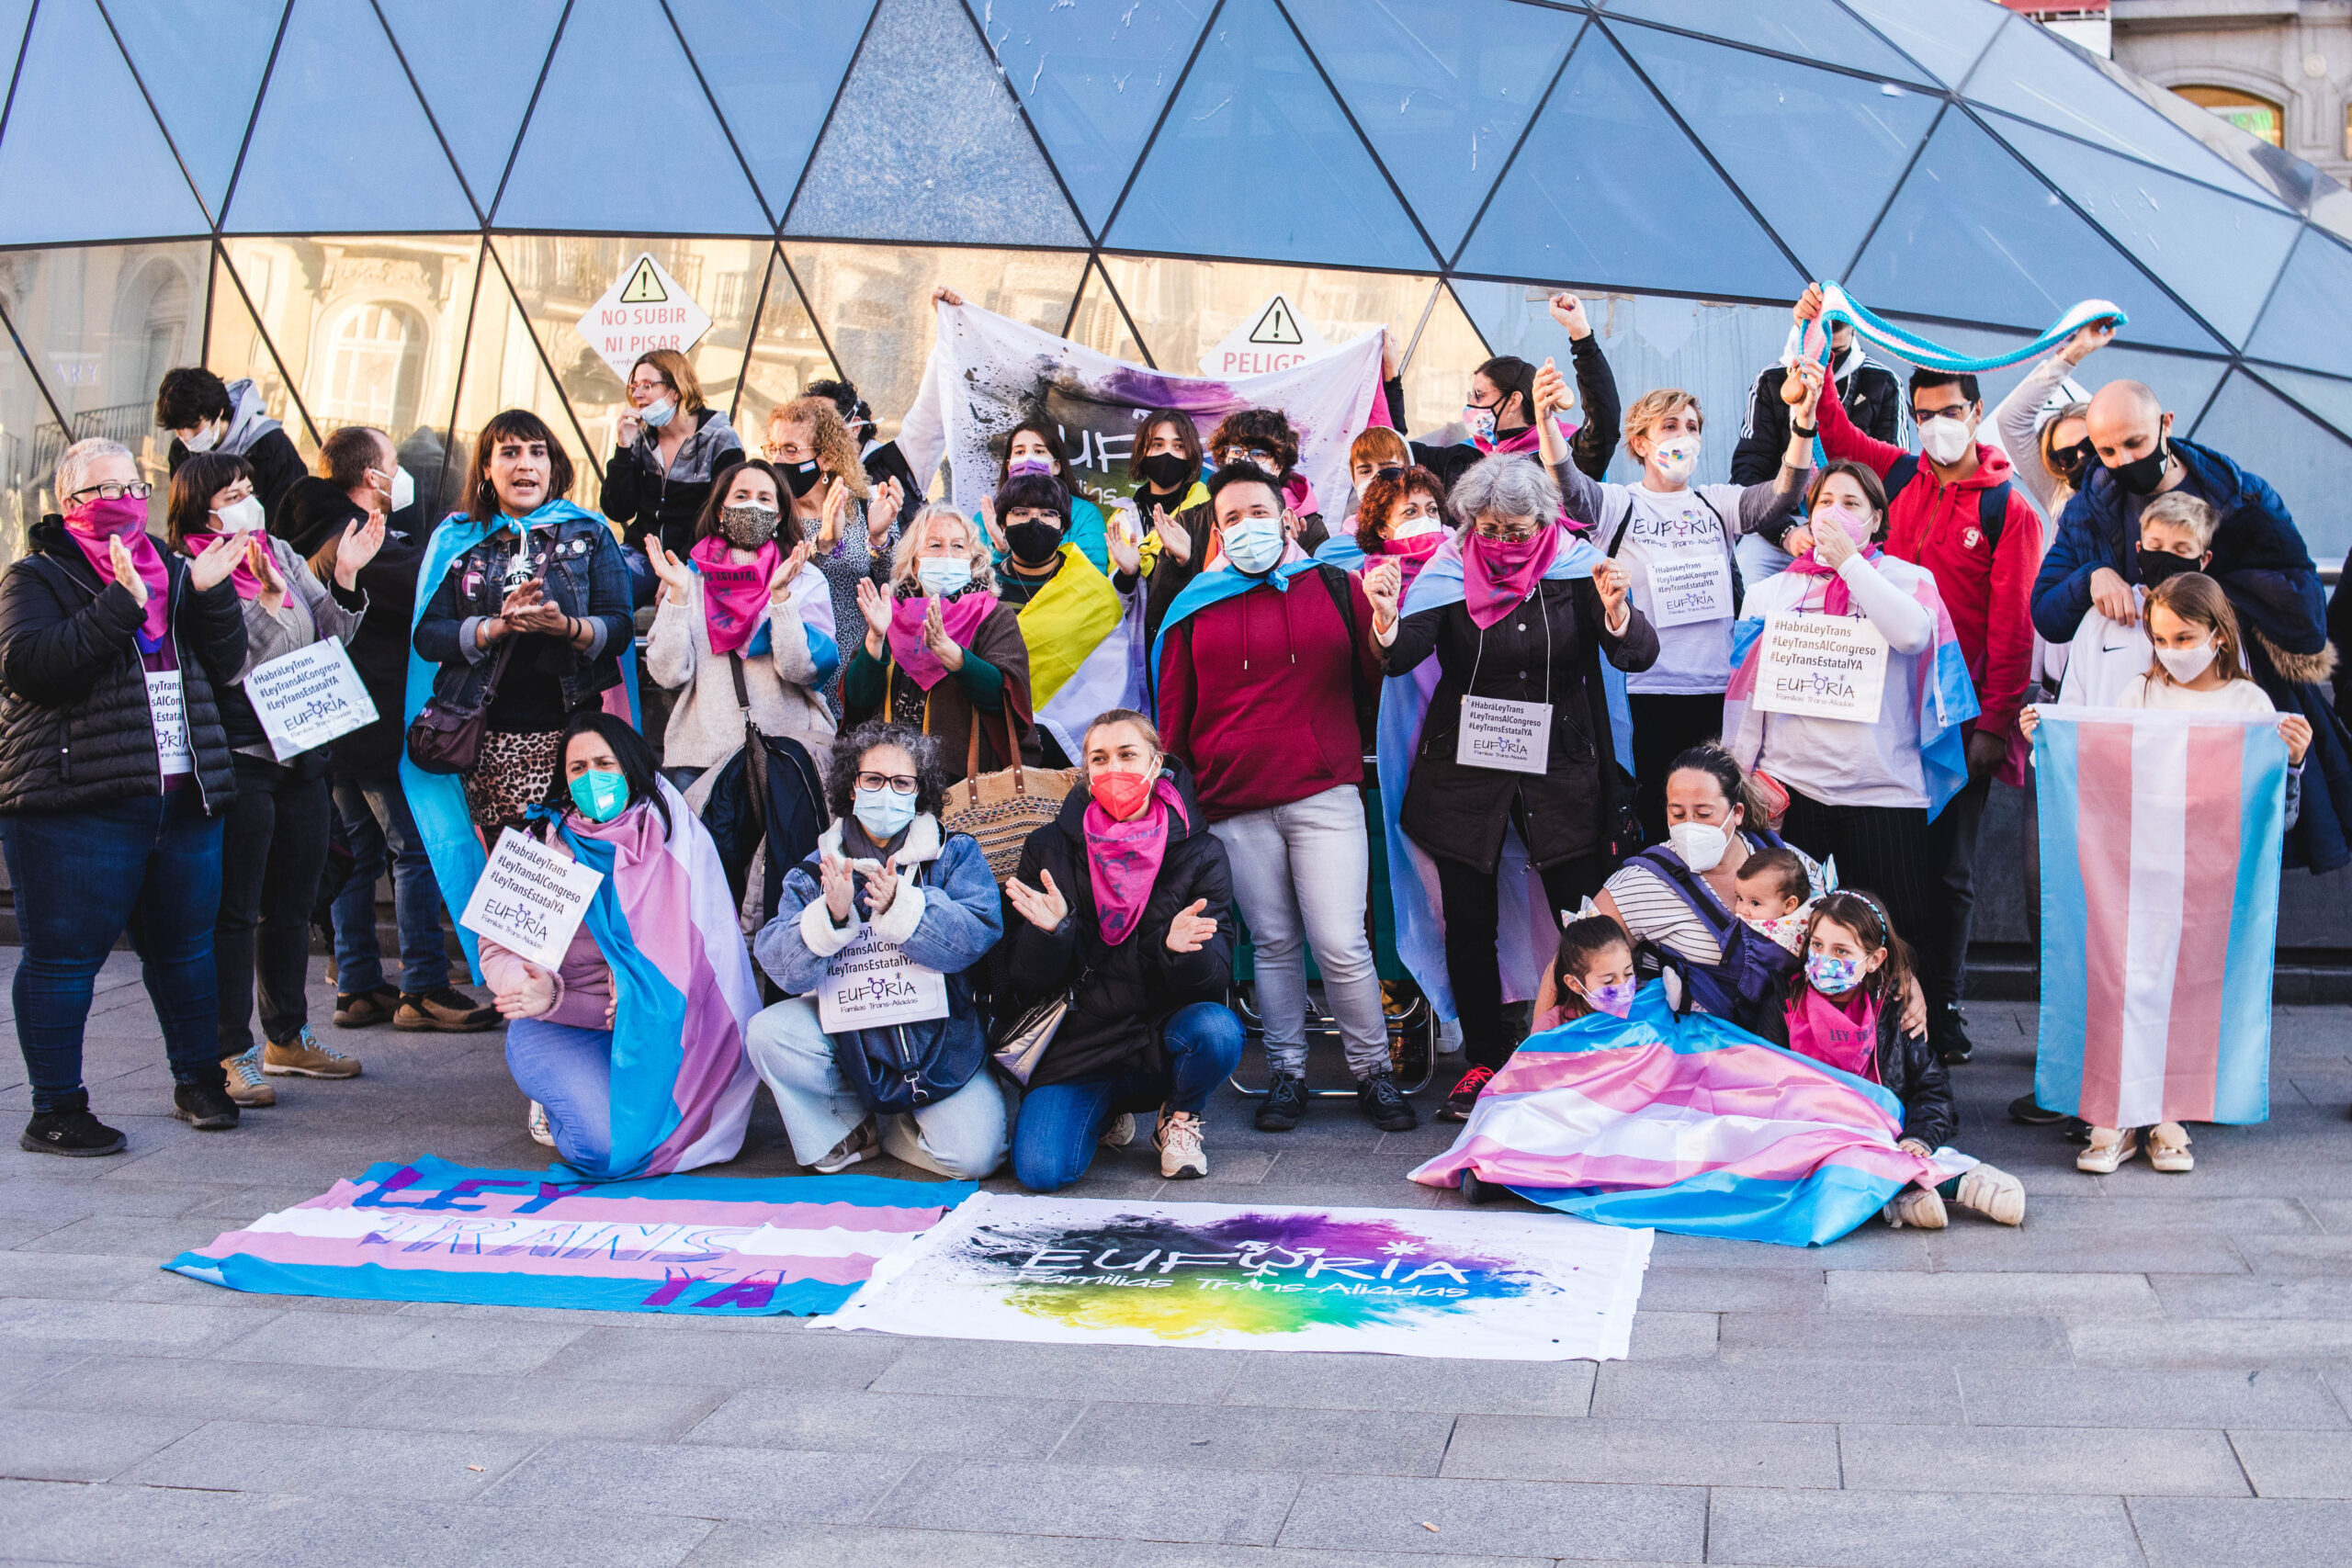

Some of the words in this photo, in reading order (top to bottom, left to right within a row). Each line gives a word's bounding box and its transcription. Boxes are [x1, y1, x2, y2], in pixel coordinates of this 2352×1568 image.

[601, 310, 627, 326] NO
[633, 308, 686, 325] SUBIR
[605, 336, 623, 353] NI
[630, 334, 681, 353] PISAR
[1964, 529, 1980, 547] 9
[717, 571, 757, 581] ESTATAL
[1658, 580, 1714, 593] #LeyTransEstatalYA
[1774, 619, 1852, 637] #HabráLeyTrans
[1772, 636, 1877, 656] #LeyTransAlCongreso
[254, 656, 314, 685] #HabráLeyTrans
[1770, 651, 1863, 671] #LeyTransEstatalYA
[149, 681, 181, 694] eyTrans
[259, 661, 341, 698] #LeyTransAlCongreso
[266, 675, 339, 712] #LeyTransEstatalYA
[1471, 701, 1524, 714] #HabráLeyTrans
[1469, 711, 1542, 727] #LeyTransAlCongreso
[1468, 722, 1532, 737] #LeyTransEstatalYA
[505, 840, 568, 877] #HabráLeyTrans
[498, 854, 581, 904] #LeyTransAlCongreso
[490, 870, 565, 915] #LeyTransEstatalYA
[1099, 904, 1125, 930] YA
[840, 1004, 866, 1013] Familias
[1830, 1029, 1849, 1042] LEY
[352, 1165, 599, 1213] LEY
[356, 1214, 765, 1263] TRANS
[1022, 1240, 1471, 1284] EUFORIA
[640, 1267, 787, 1309] YA
[1016, 1270, 1173, 1290] Familias
[1195, 1278, 1470, 1298] Trans-Aliadas
